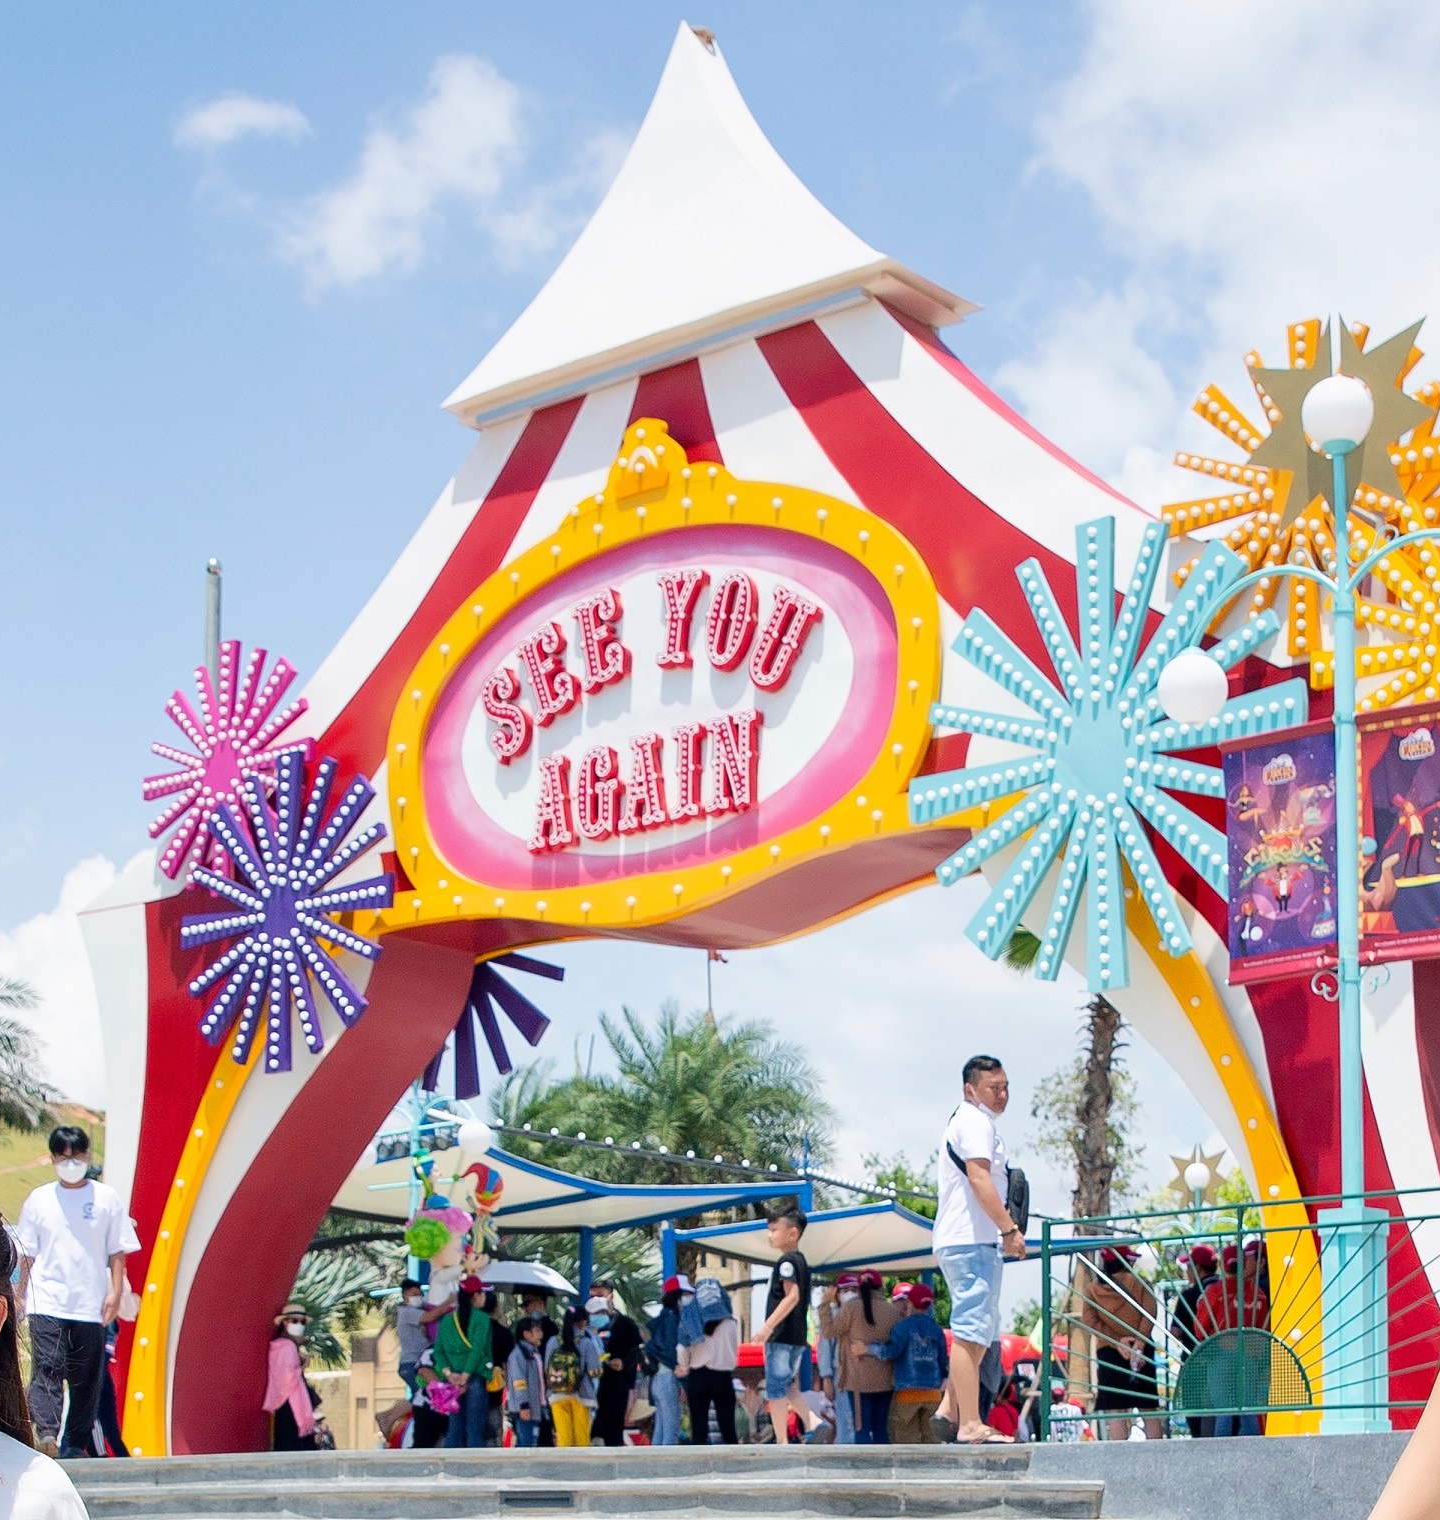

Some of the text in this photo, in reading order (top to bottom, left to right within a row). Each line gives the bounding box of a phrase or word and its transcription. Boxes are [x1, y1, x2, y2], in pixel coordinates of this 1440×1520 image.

[482, 569, 823, 766] SEE YOU
[527, 709, 763, 854] AGAIN
[1243, 836, 1323, 867] CIRCUS
